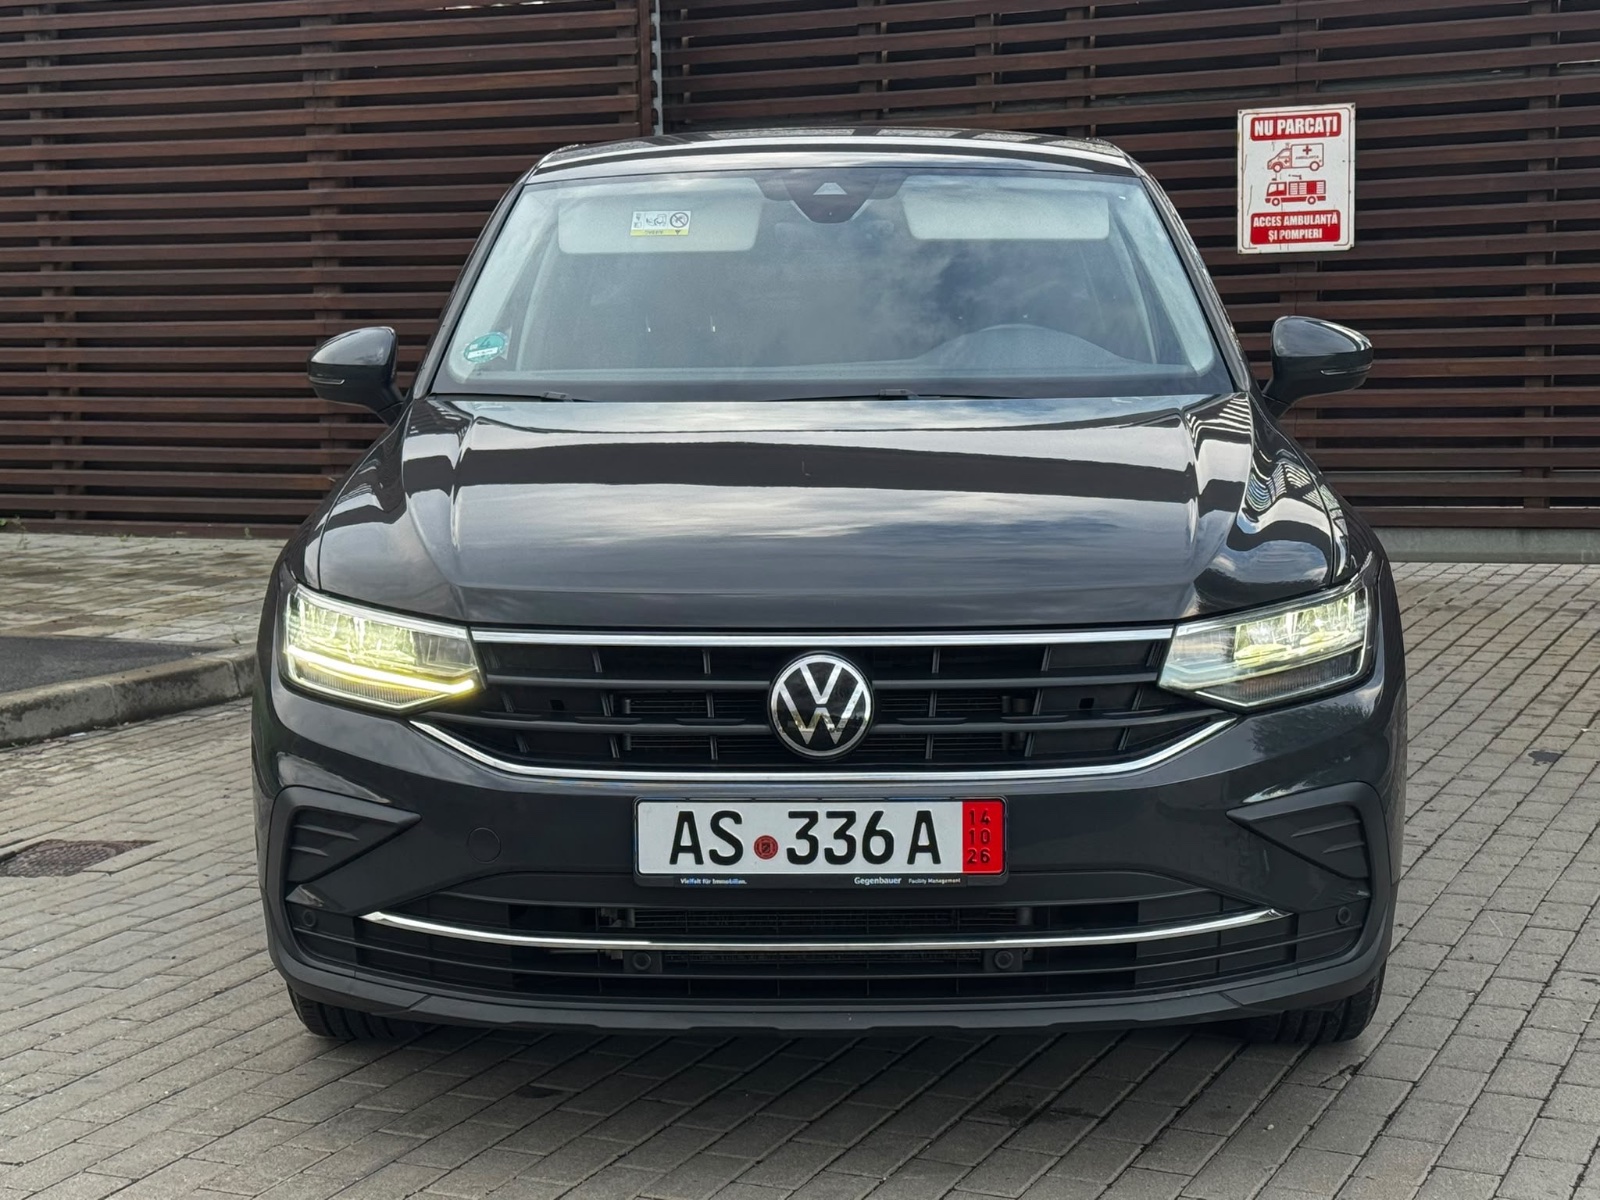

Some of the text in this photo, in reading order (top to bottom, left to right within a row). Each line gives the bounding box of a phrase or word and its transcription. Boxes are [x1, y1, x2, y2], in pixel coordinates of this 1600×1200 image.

[1254, 116, 1338, 137] NU PARCAȚI
[1253, 216, 1282, 228] ACCES
[1279, 228, 1323, 240] POMPIERI
[968, 808, 991, 826] 14
[669, 810, 942, 866] AS 336 A
[968, 827, 991, 845] 10
[967, 847, 991, 864] 26
[853, 876, 961, 886] Gegenbauer Facility Management
